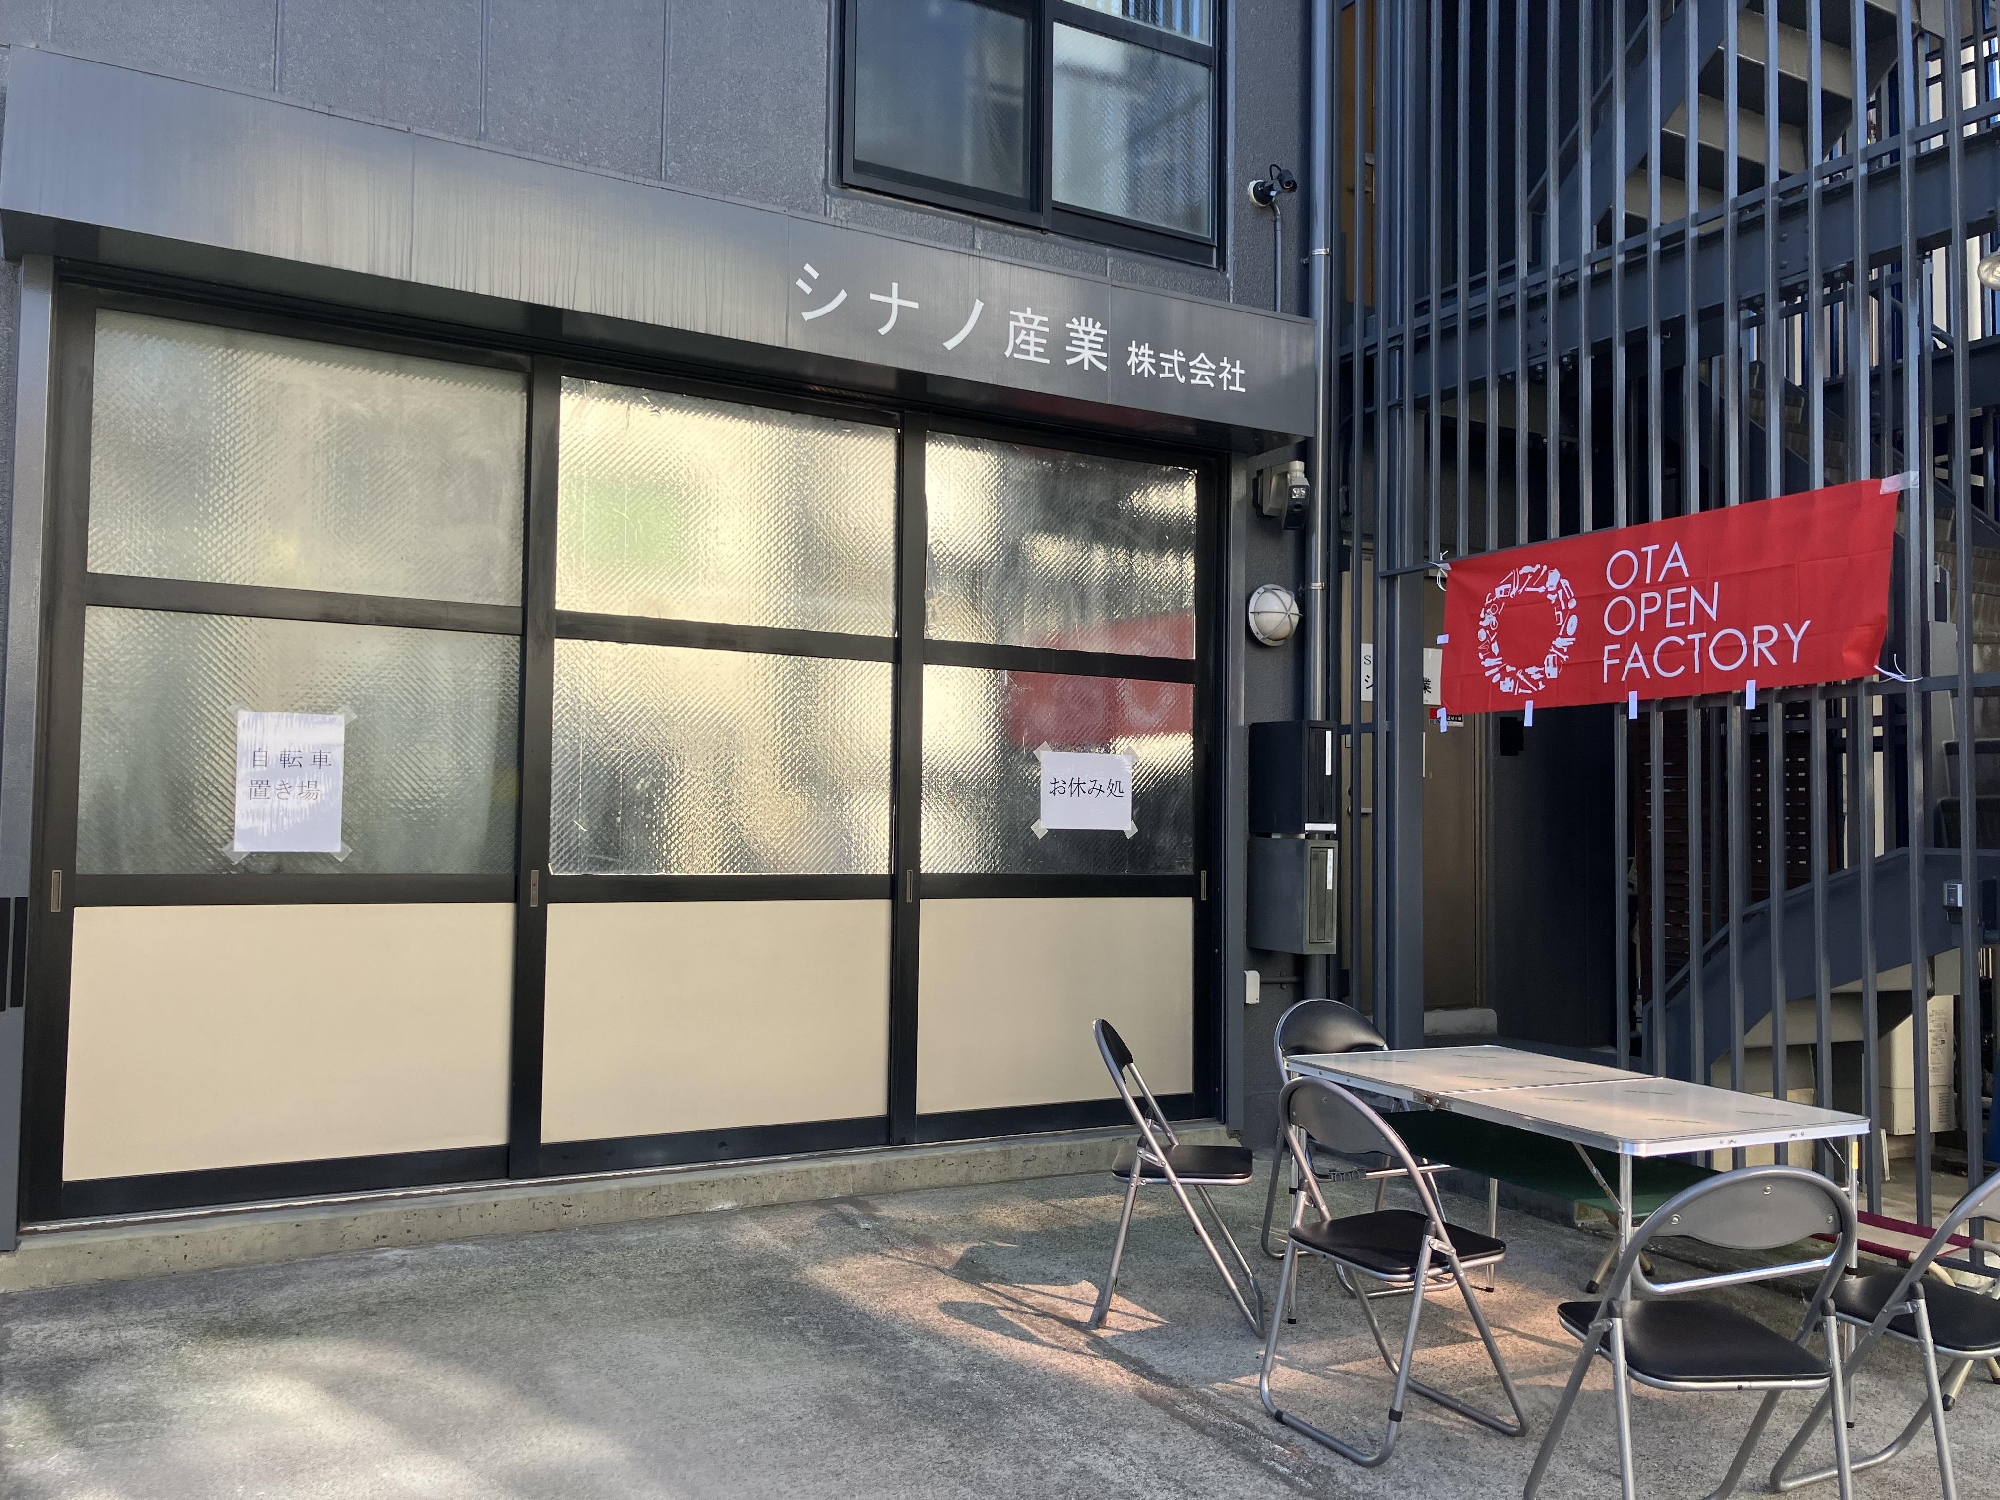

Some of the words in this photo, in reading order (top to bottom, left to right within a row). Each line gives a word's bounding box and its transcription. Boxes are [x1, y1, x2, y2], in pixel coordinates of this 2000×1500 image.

[795, 262, 1108, 372] シナノ産業
[1126, 339, 1246, 393] 株式会社
[1606, 541, 1690, 590] OTA
[1603, 581, 1719, 636] OPEN
[1603, 619, 1812, 684] FACTORY
[252, 747, 332, 770] 自転車
[248, 779, 321, 801] 置き場
[1049, 776, 1125, 798] お休み処
